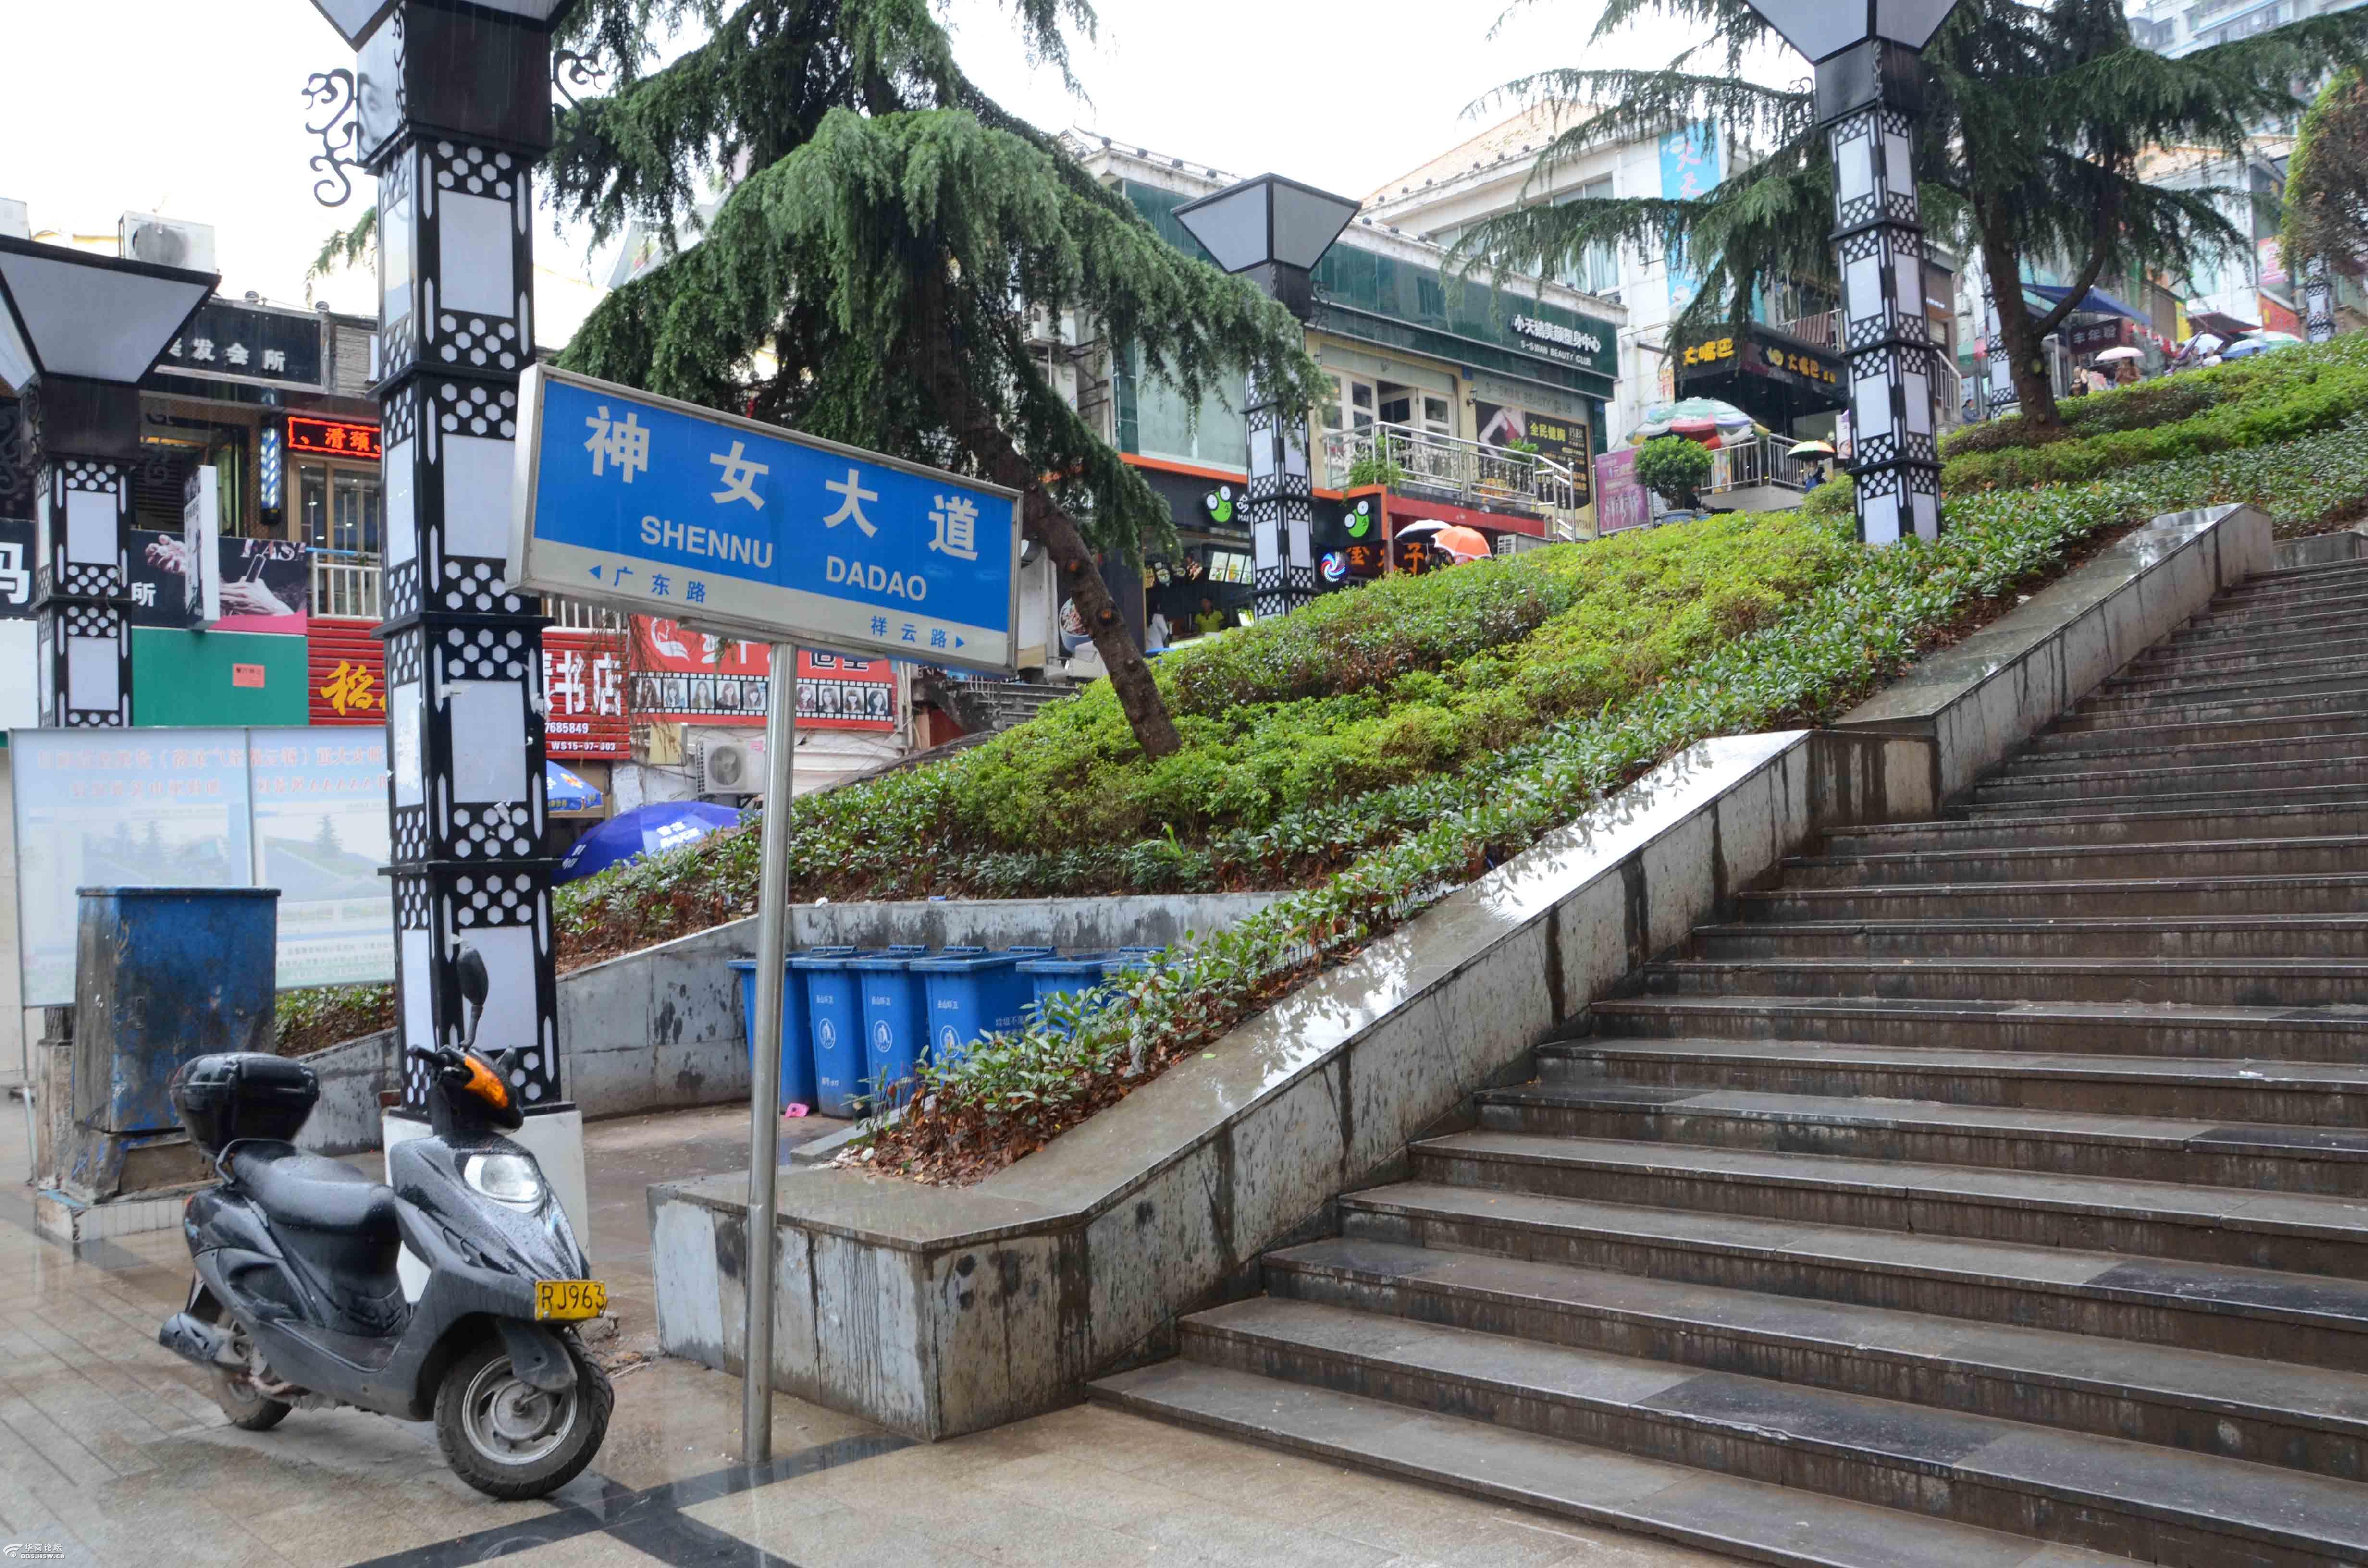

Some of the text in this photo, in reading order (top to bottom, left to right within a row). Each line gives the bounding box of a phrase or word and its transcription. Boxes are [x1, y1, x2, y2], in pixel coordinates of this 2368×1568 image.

[1550, 348, 1574, 361] BEAUTY
[1577, 355, 1592, 366] CLUB
[584, 405, 978, 561] 神女大道
[640, 515, 927, 602] SHENNU DADAO
[614, 566, 706, 603] 广东路
[871, 616, 947, 649] 祥云路
[542, 1284, 604, 1311] RJ963
